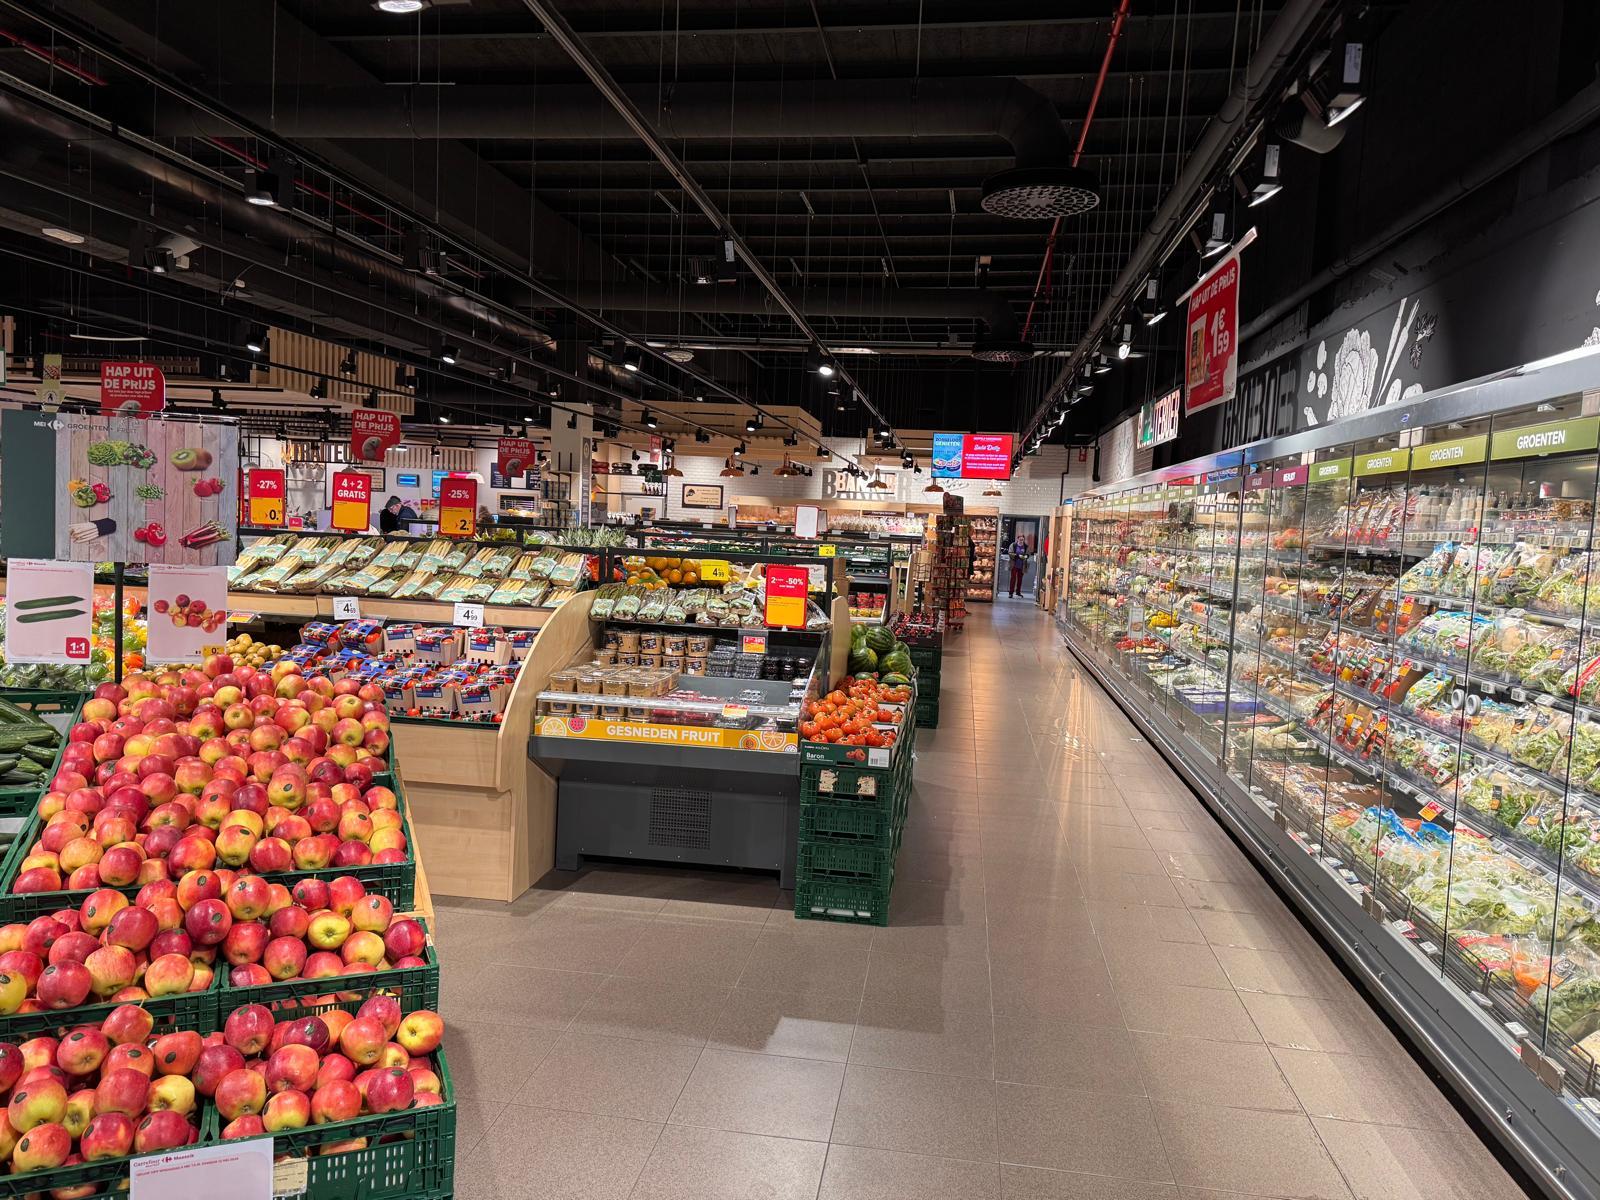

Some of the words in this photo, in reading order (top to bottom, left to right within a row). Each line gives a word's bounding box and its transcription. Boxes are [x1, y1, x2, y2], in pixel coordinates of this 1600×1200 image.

[1190, 293, 1201, 312] HAP
[1201, 285, 1211, 305] UIT
[1210, 279, 1219, 298] DE
[1218, 266, 1236, 292] PRIJS
[105, 365, 131, 377] HAP
[133, 366, 154, 378] UIT
[104, 378, 120, 389] DE
[122, 378, 156, 391] PRIJS
[356, 412, 376, 421] HAP
[377, 414, 394, 423] UIT
[67, 422, 109, 432] GROENTEN
[354, 420, 367, 429] DE
[368, 422, 394, 432] PRIJS
[1517, 429, 1566, 450] GROENTEN
[1429, 446, 1464, 463] GROENTEN
[1366, 457, 1393, 469] GROENTEN
[256, 480, 278, 490] -27%
[341, 479, 348, 488] 4
[357, 480, 364, 489] 2
[337, 489, 366, 499] GRATIS
[447, 489, 470, 500] -25%
[785, 577, 804, 586] -50%
[606, 724, 678, 740] GESNEDEN
[681, 729, 721, 743] FRUIT
[806, 751, 825, 760] Baron
